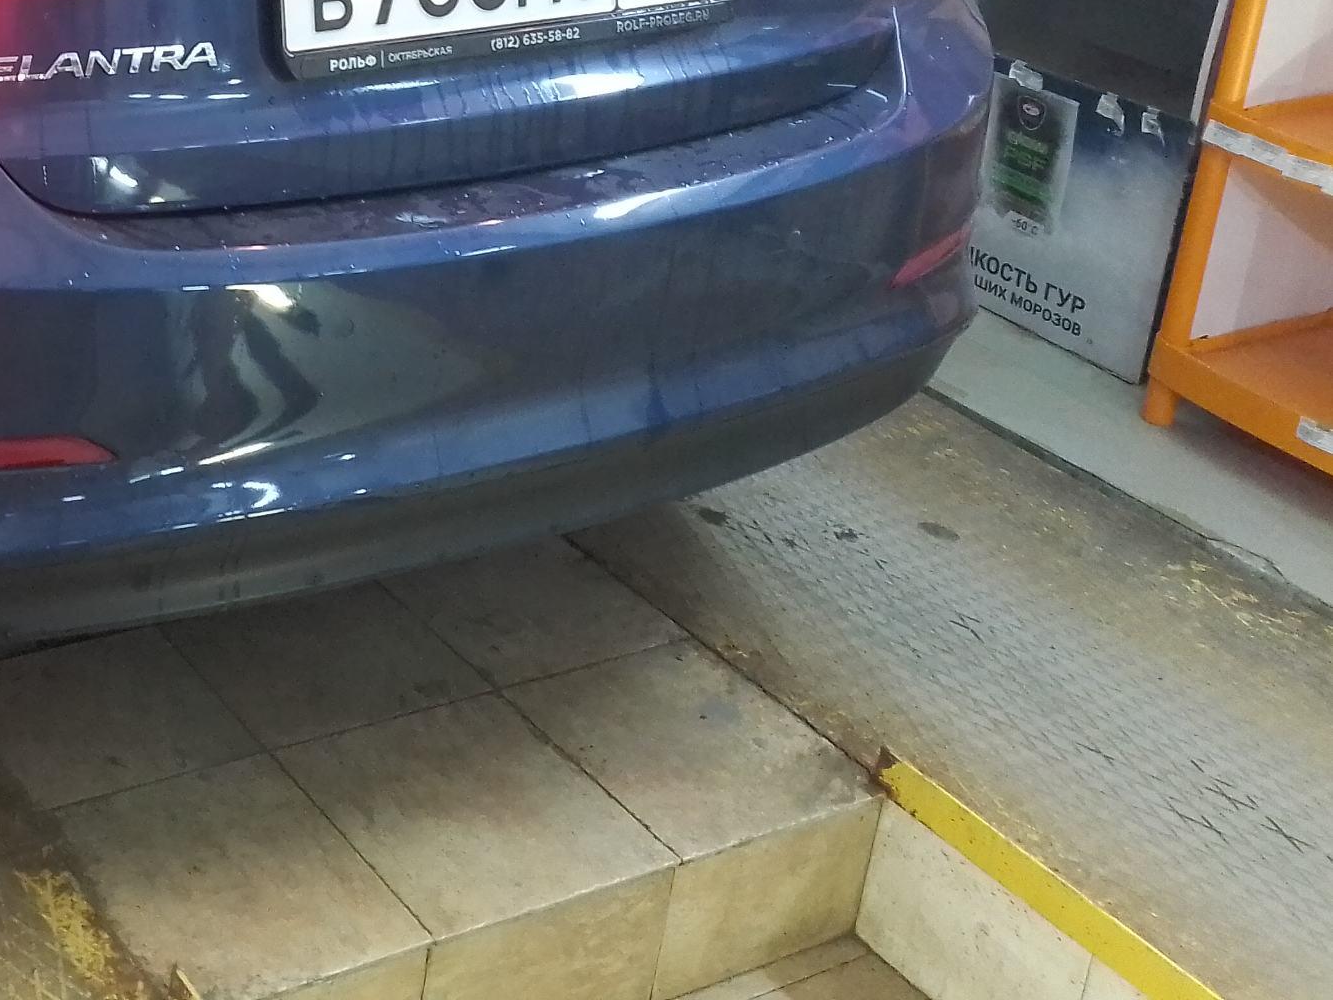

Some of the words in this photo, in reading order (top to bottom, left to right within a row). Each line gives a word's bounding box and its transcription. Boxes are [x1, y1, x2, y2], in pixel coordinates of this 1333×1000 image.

[329, 55, 377, 72] РОЛЬФ
[388, 46, 453, 63] ОКТЯБРЬСКАЯ
[490, 34, 520, 52] (812)
[522, 27, 581, 47] 635-58-82
[971, 246, 1038, 294] КОСТЬ
[1044, 282, 1086, 313] ГУР
[1010, 292, 1081, 336] МОРОЗОВ
